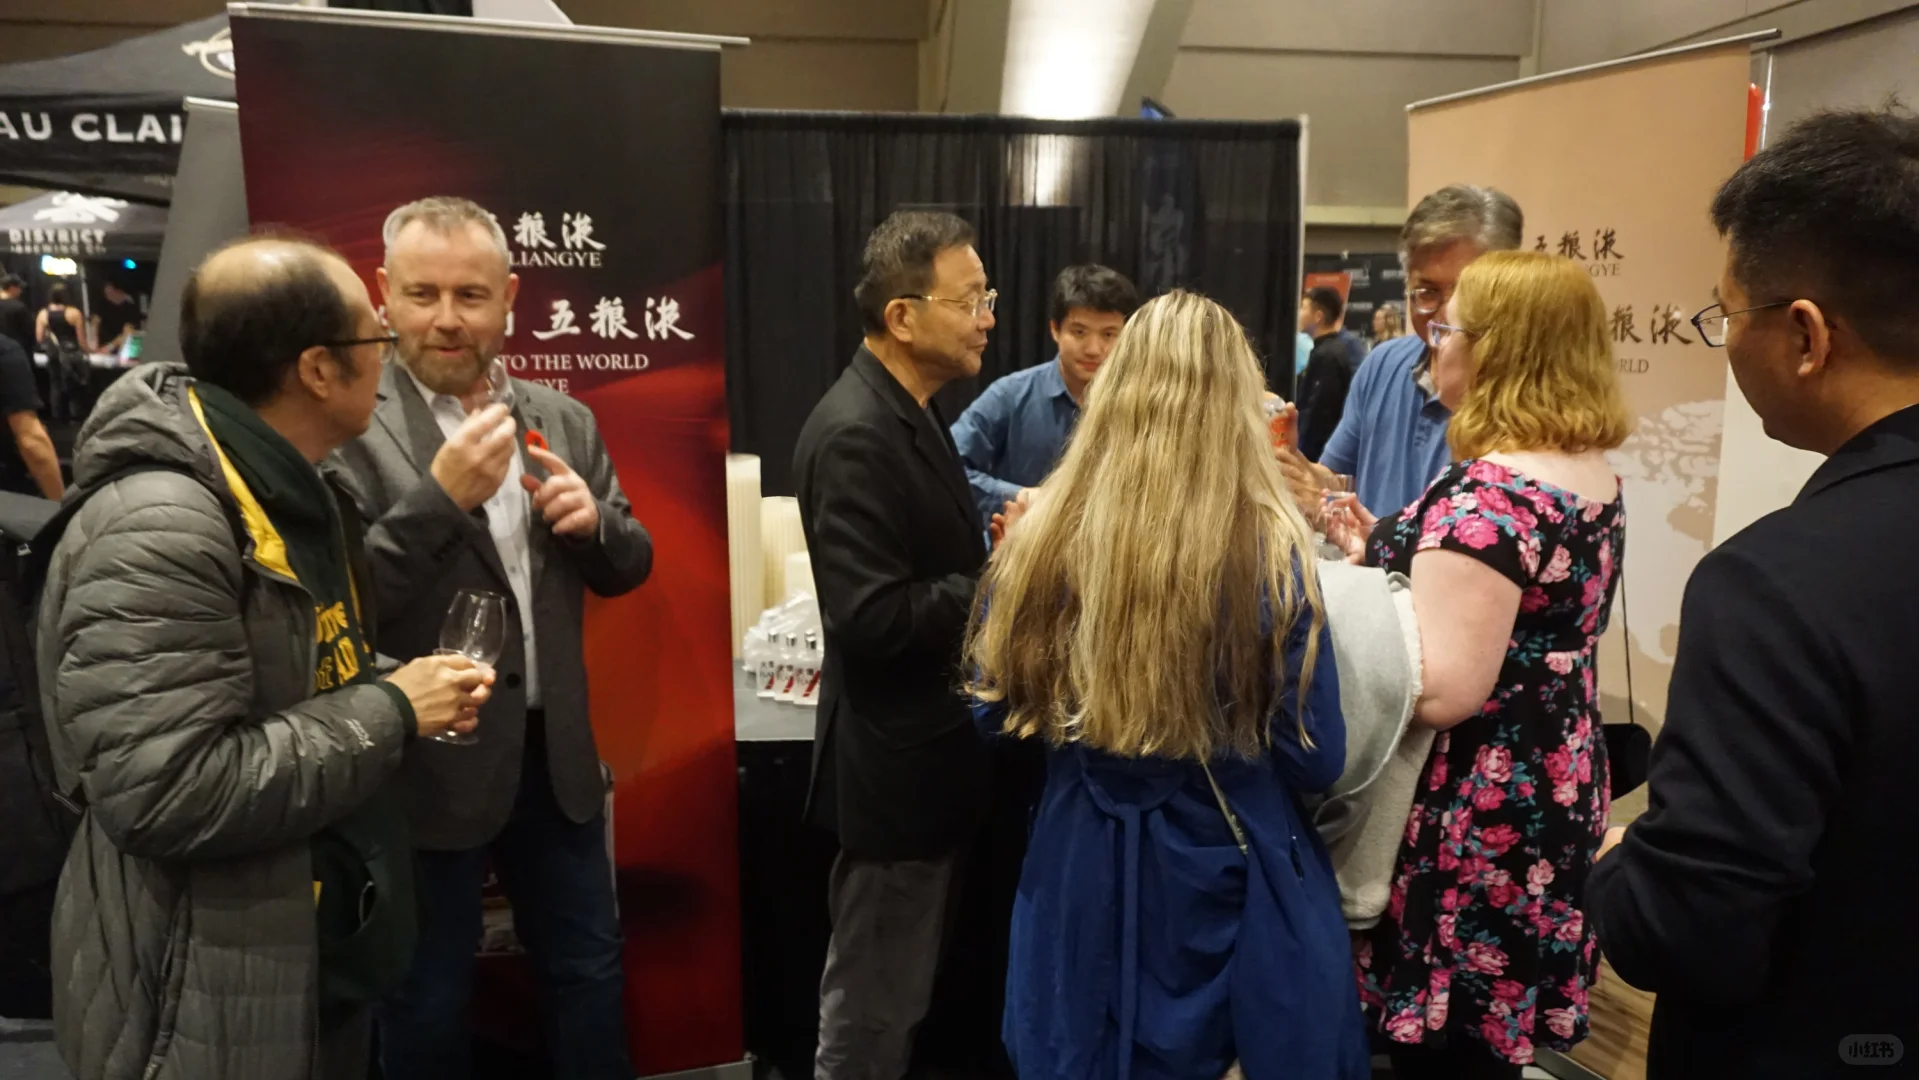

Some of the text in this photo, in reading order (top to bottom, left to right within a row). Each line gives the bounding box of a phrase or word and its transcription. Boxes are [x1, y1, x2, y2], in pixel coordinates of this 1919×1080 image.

[8, 228, 107, 244] DISTRICT
[530, 354, 573, 371] THE
[576, 353, 650, 371] WORLD
